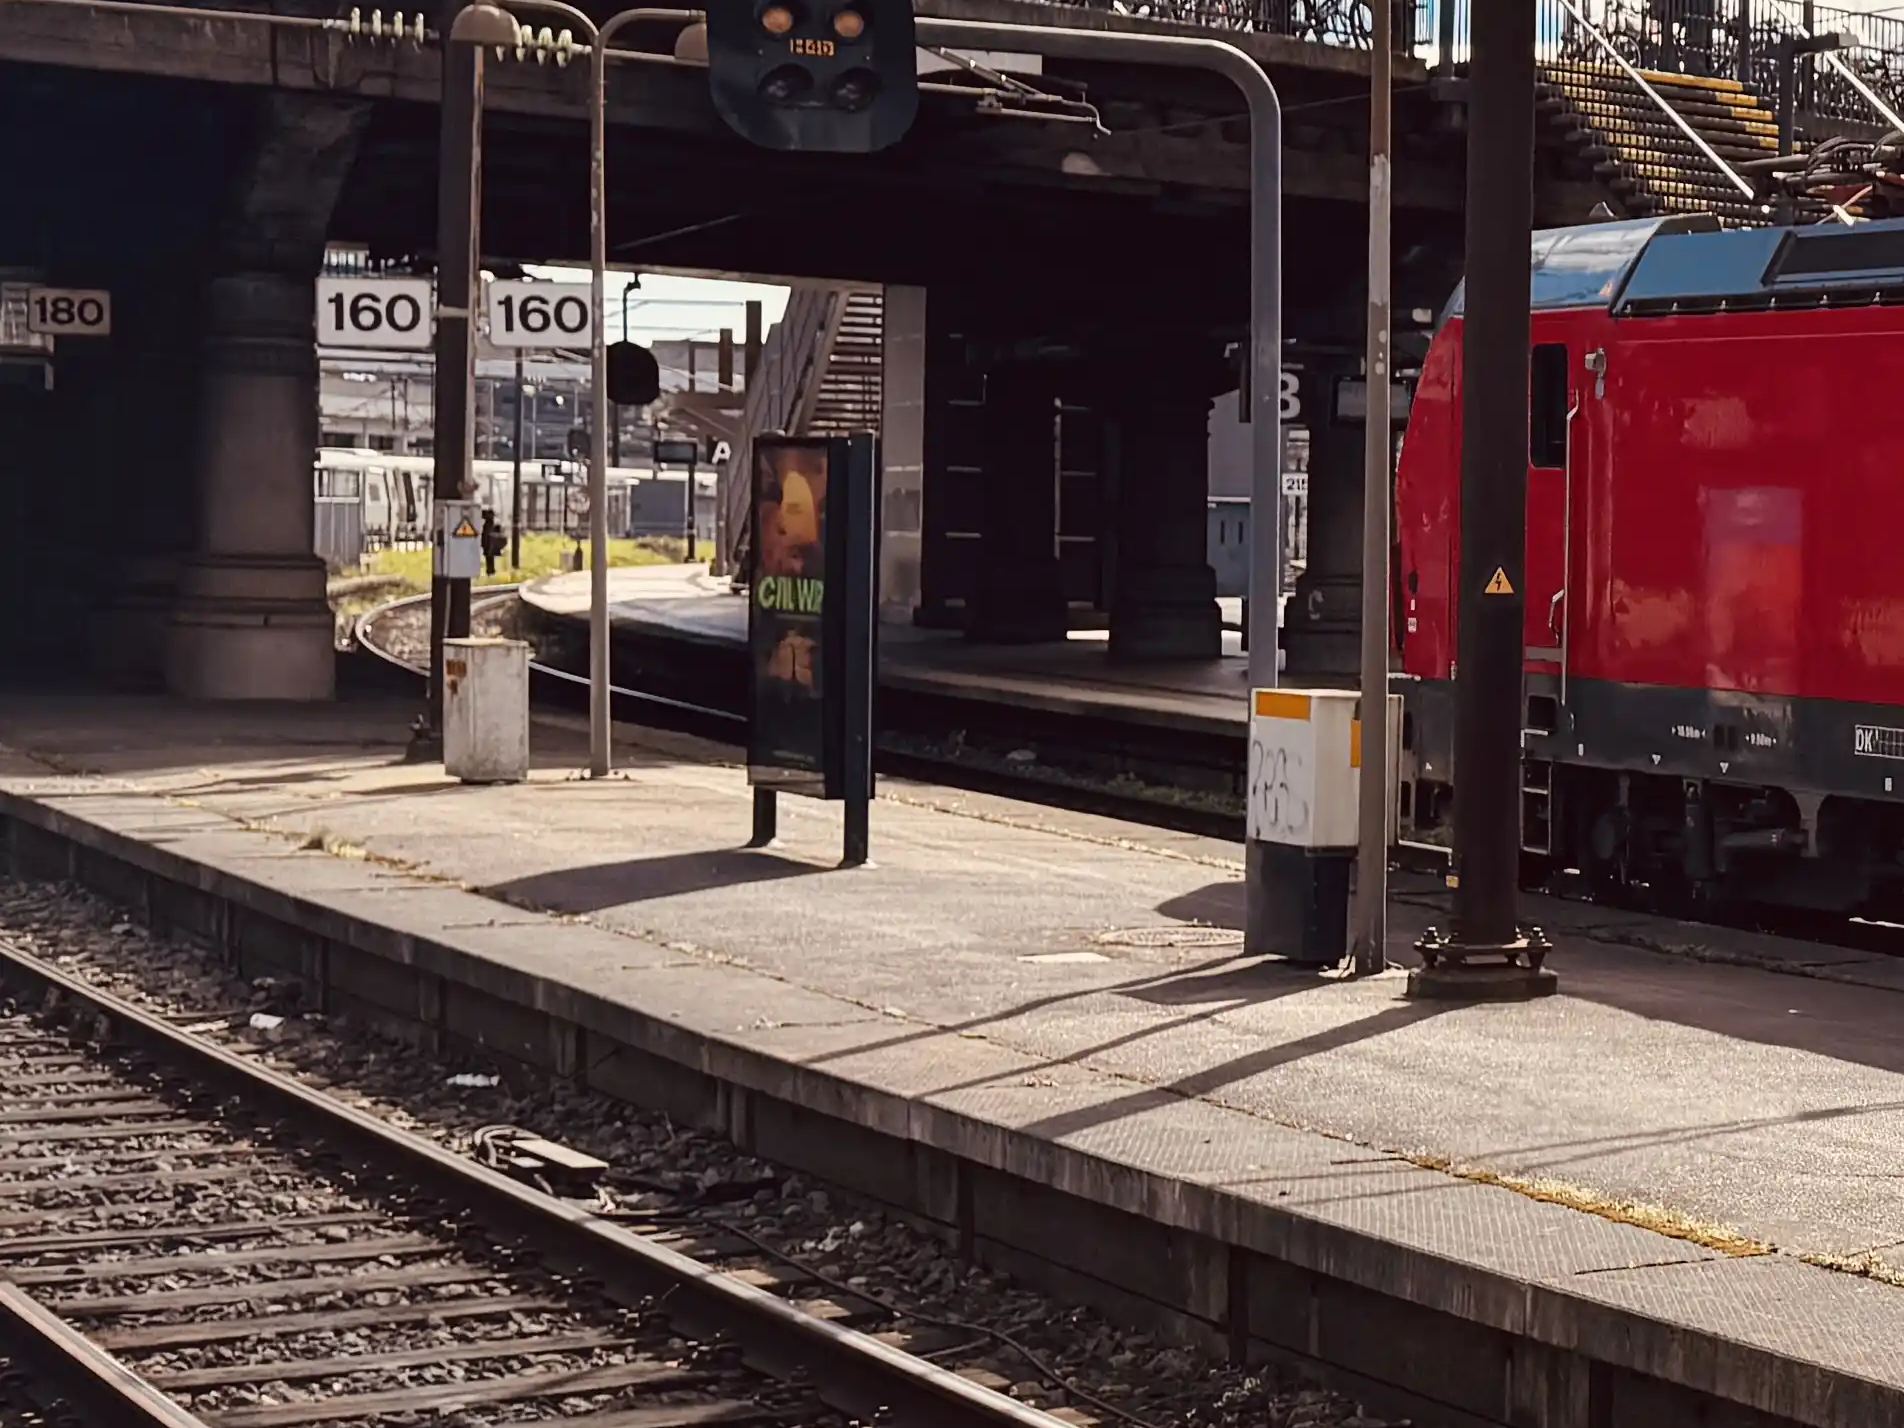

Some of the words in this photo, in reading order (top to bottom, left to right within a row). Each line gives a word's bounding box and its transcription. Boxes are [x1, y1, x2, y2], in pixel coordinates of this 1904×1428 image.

[34, 296, 104, 326] 180
[328, 292, 420, 332] 160
[497, 295, 588, 333] 160
[711, 441, 731, 464] A
